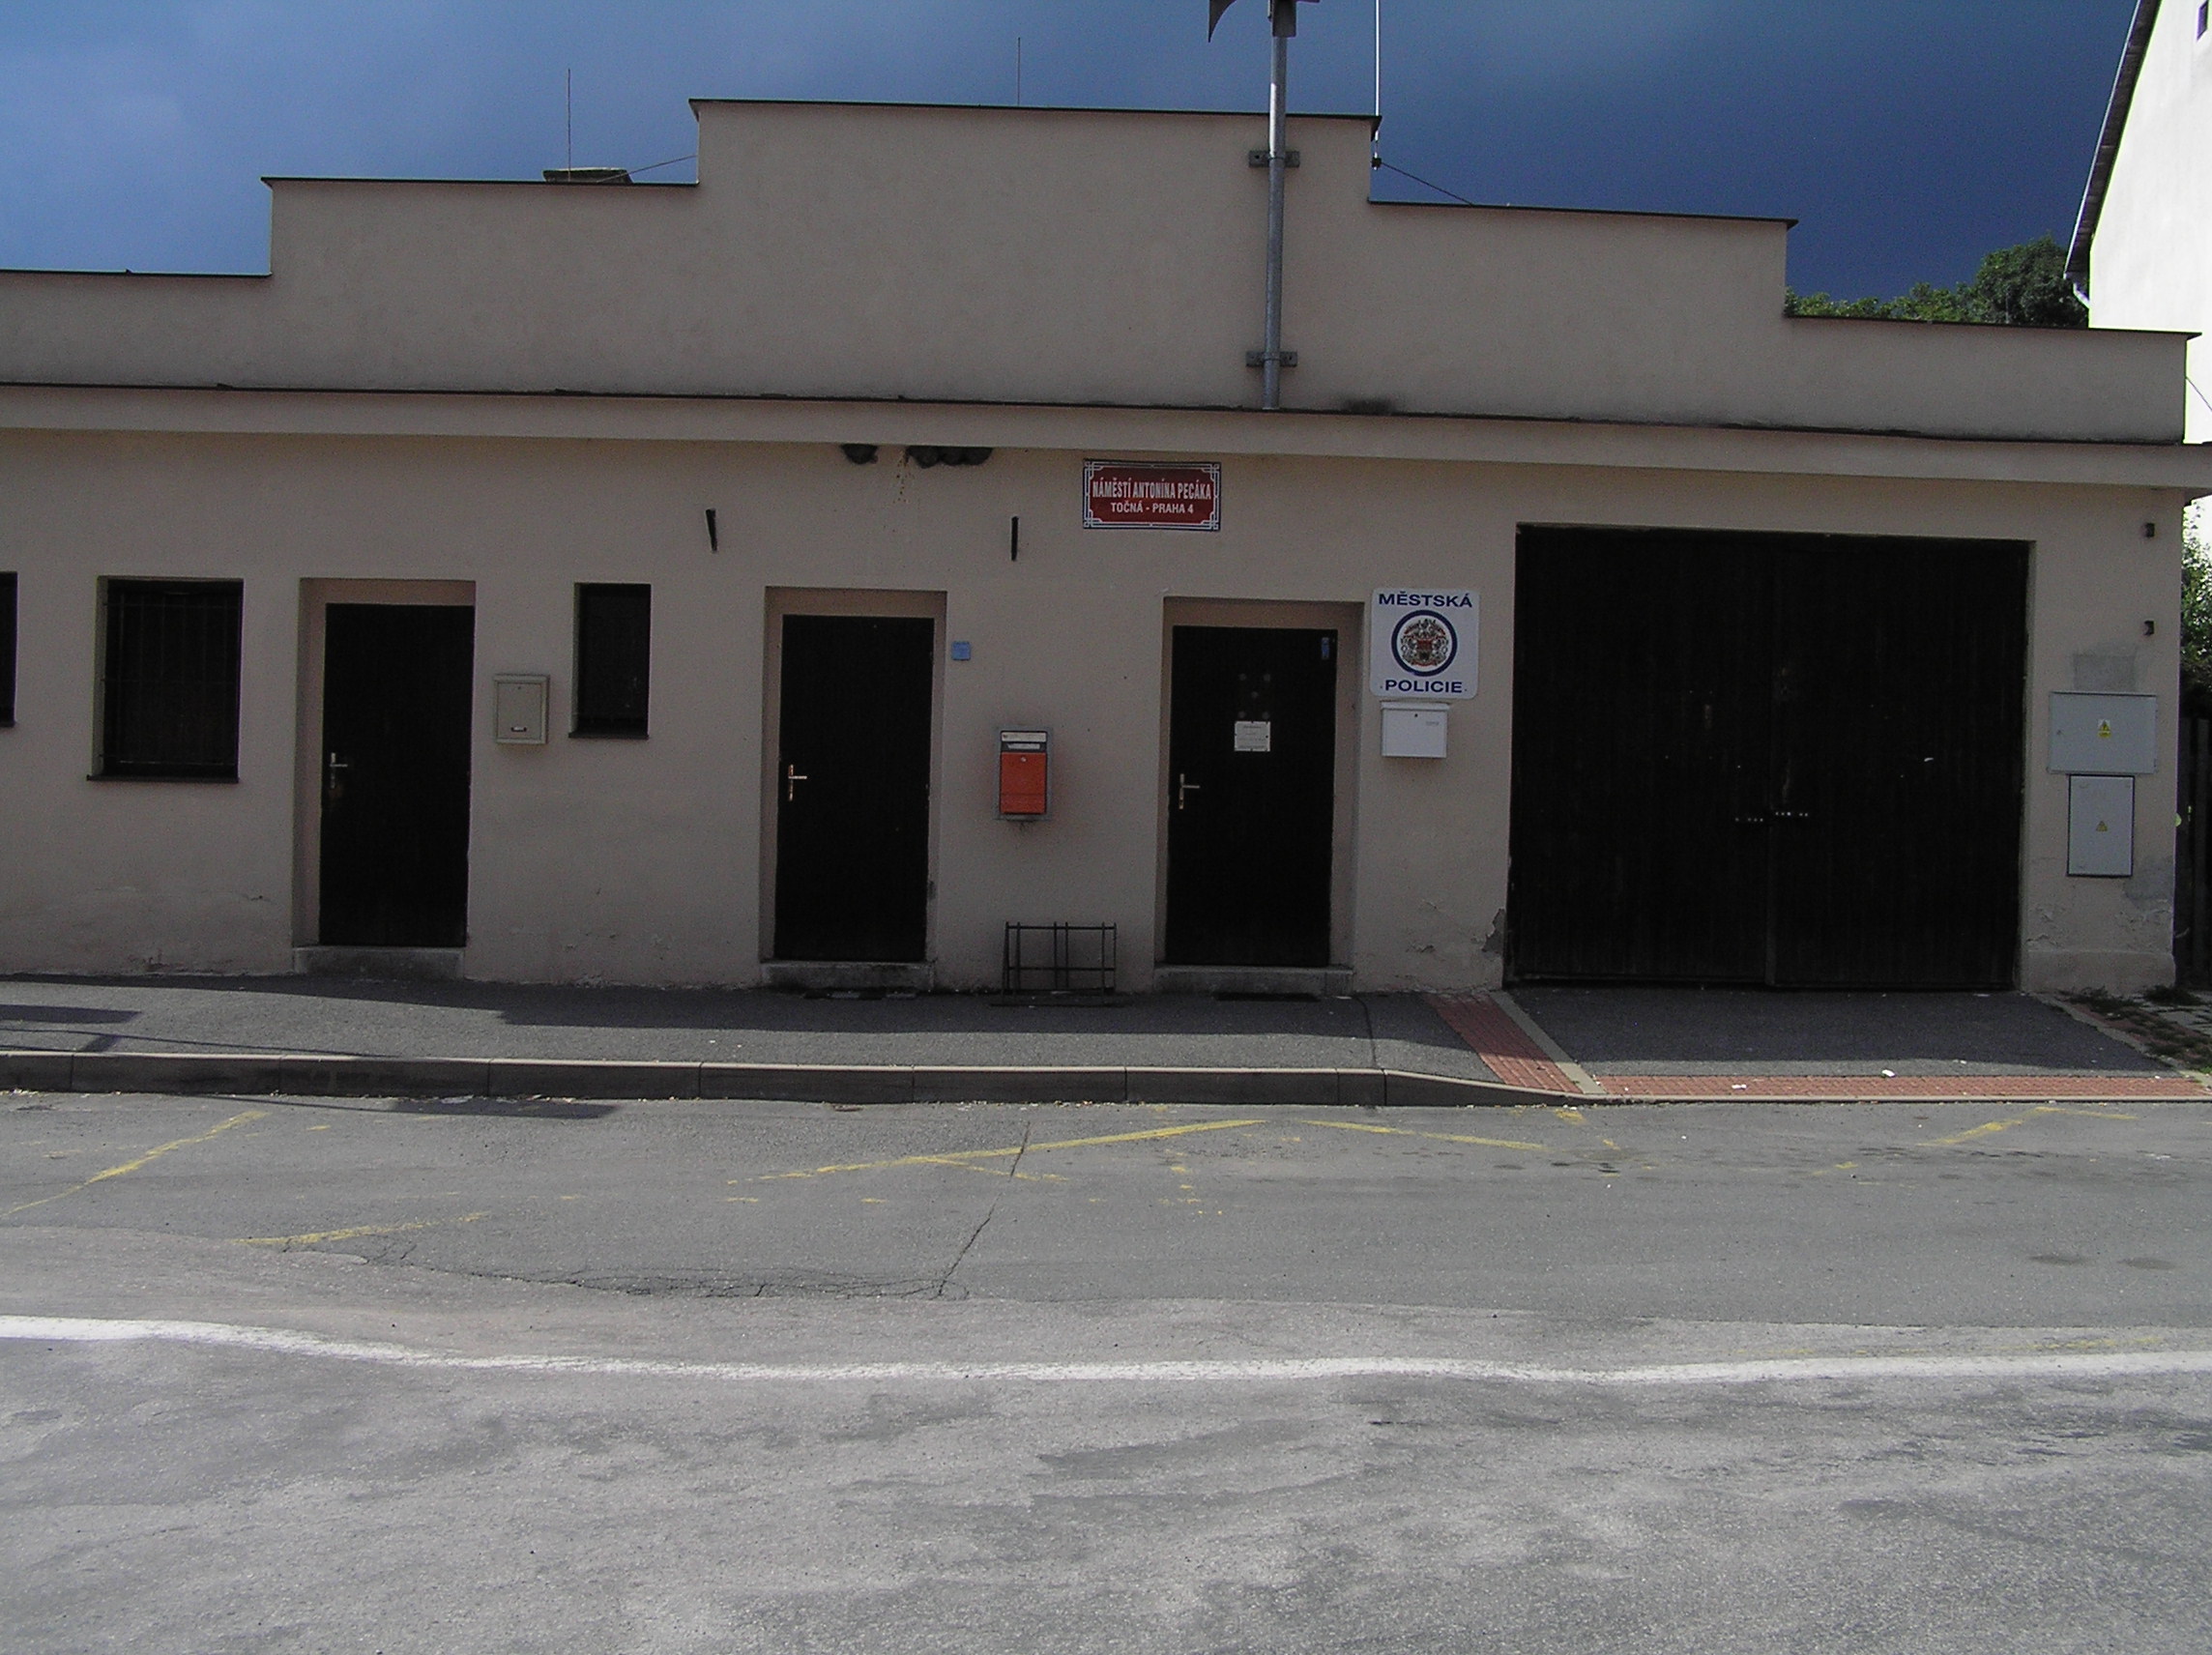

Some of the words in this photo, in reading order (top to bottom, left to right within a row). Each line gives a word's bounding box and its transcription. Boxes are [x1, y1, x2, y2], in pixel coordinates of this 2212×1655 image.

[1092, 477, 1132, 498] NÁMĚSTÍ
[1132, 478, 1176, 499] ANTONÍNA
[1177, 479, 1211, 500] PECÁKA
[1111, 500, 1144, 512] TOČNÁ
[1152, 504, 1185, 513] PRAHA
[1187, 504, 1194, 514] 4
[1379, 591, 1472, 608] MĚSTSKÁ
[1384, 679, 1463, 693] POLICIE
